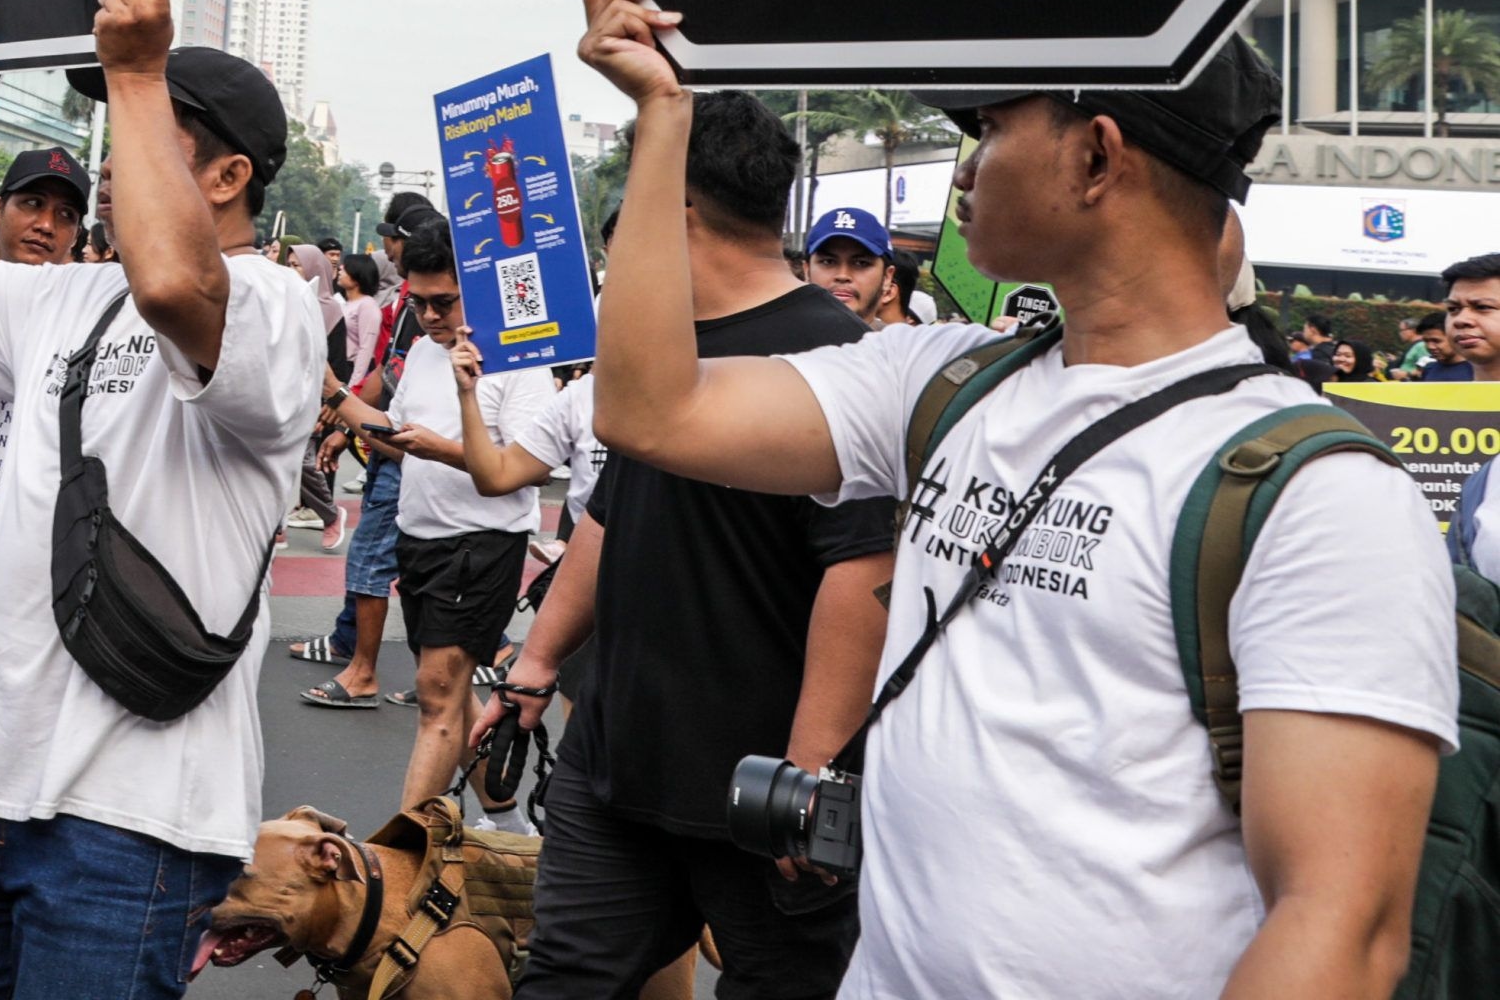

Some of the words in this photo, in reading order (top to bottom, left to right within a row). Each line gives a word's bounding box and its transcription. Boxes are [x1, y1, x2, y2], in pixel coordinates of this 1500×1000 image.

[441, 91, 497, 121] Minumnya
[496, 76, 540, 102] Murah,
[443, 114, 496, 141] Risikonya
[495, 98, 532, 124] Mahal
[834, 211, 856, 228] LA
